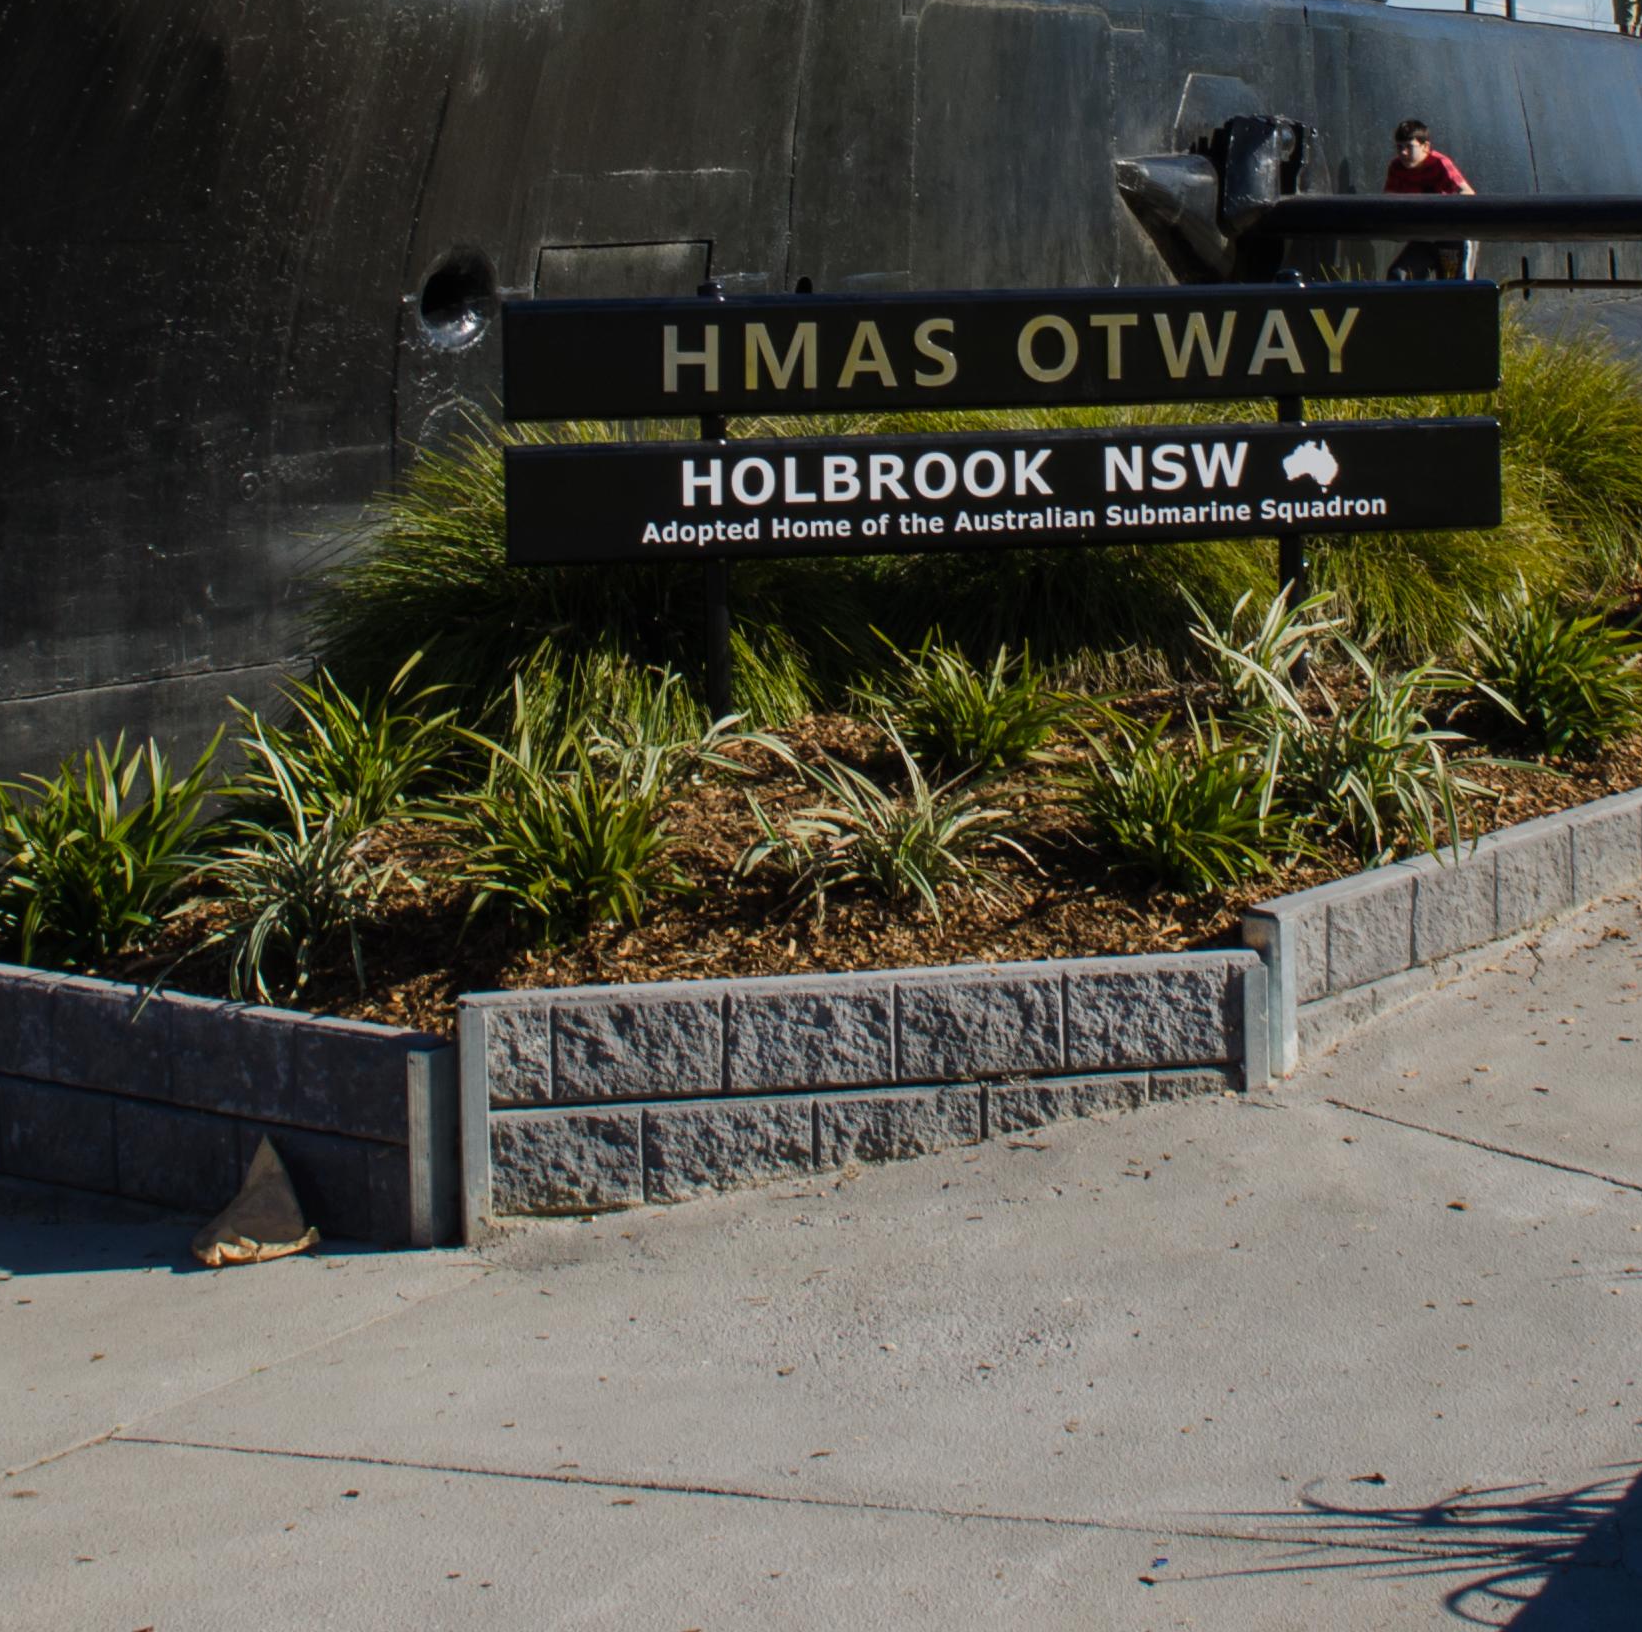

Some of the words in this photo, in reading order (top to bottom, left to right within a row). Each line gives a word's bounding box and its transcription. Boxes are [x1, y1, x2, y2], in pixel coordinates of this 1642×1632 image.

[663, 318, 958, 392] HMAS
[1017, 307, 1361, 383] OTWAY
[682, 449, 1053, 506] HOLBROOK
[1104, 441, 1249, 492] NSW
[641, 518, 760, 546] Adopted
[771, 517, 852, 539] Home
[861, 513, 891, 536] of
[898, 512, 945, 535] the
[953, 507, 1096, 532] Australian
[1105, 500, 1252, 527] Submarine
[1260, 494, 1387, 524] Squadron
